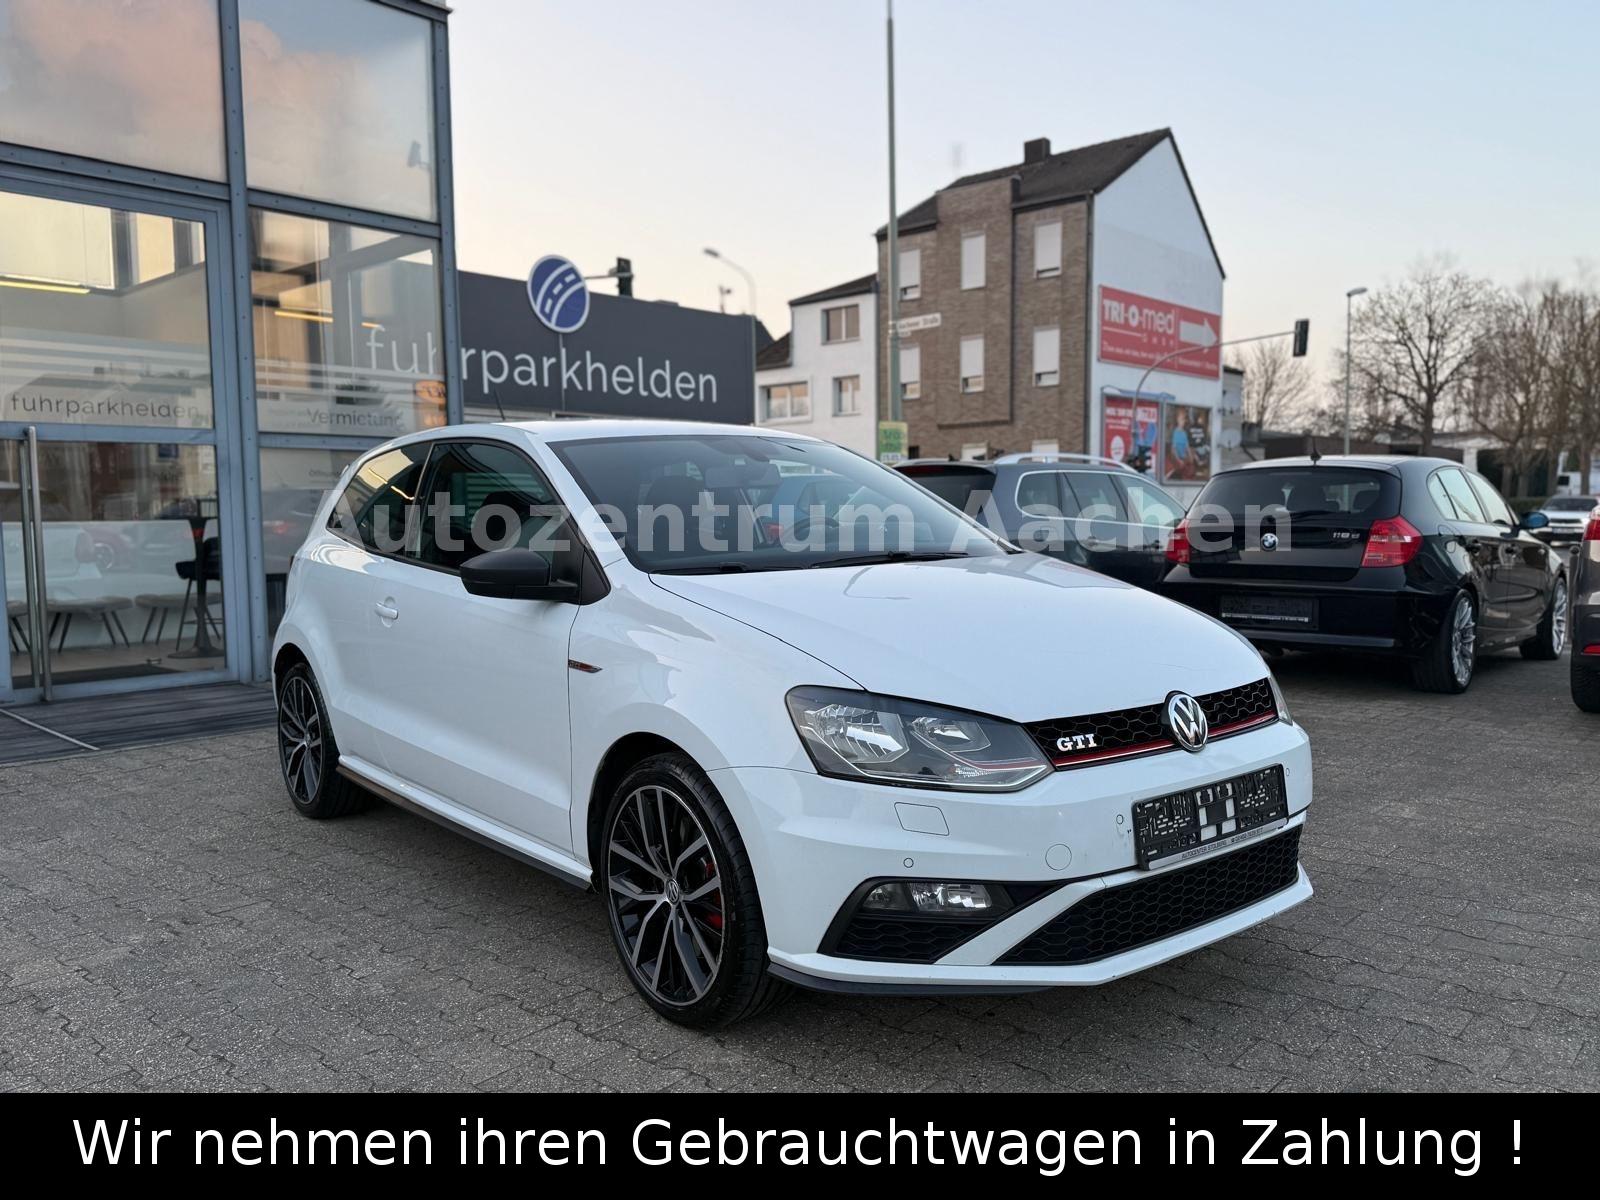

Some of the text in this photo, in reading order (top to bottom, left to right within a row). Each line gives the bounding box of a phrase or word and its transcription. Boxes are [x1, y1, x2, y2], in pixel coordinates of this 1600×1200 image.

[1102, 299, 1175, 335] TRI-O-med
[10, 391, 203, 418] fuhrparkhelden
[1056, 733, 1098, 752] GTI
